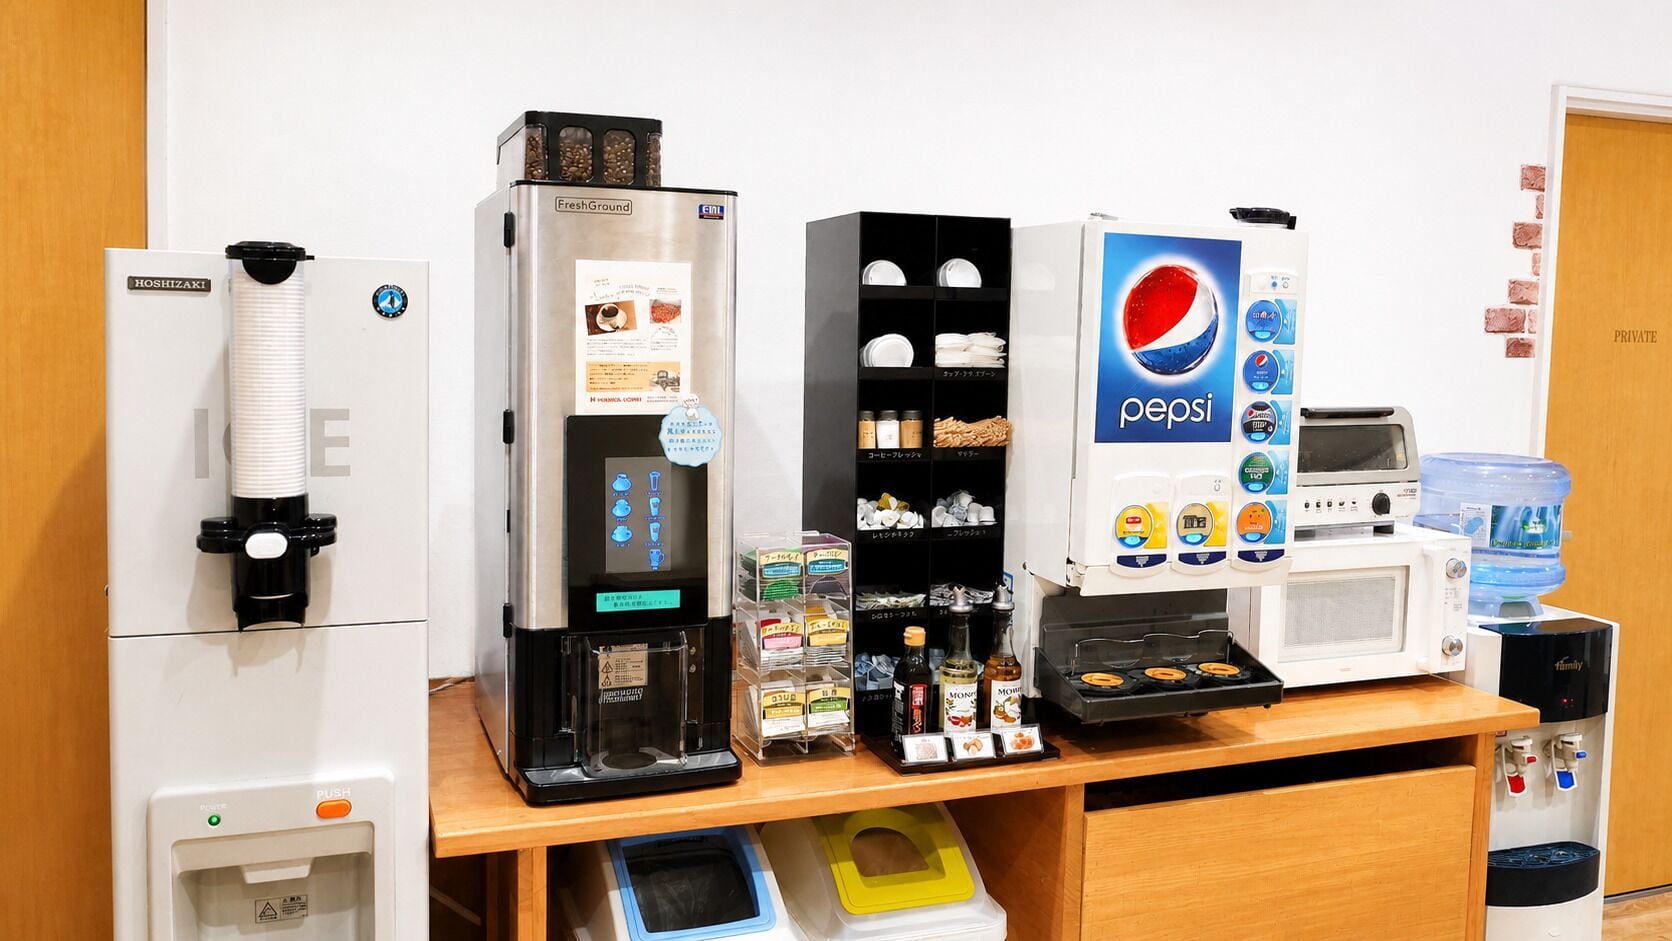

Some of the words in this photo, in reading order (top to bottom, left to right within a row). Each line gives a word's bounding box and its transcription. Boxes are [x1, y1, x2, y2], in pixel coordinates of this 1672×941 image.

[557, 199, 630, 212] FreshGround
[134, 278, 206, 290] HOSHIZAKI
[1613, 329, 1658, 344] PRIVATE
[1119, 392, 1213, 430] pepsi
[194, 408, 351, 479] IE
[1554, 658, 1584, 671] family
[316, 787, 351, 799] PUSH
